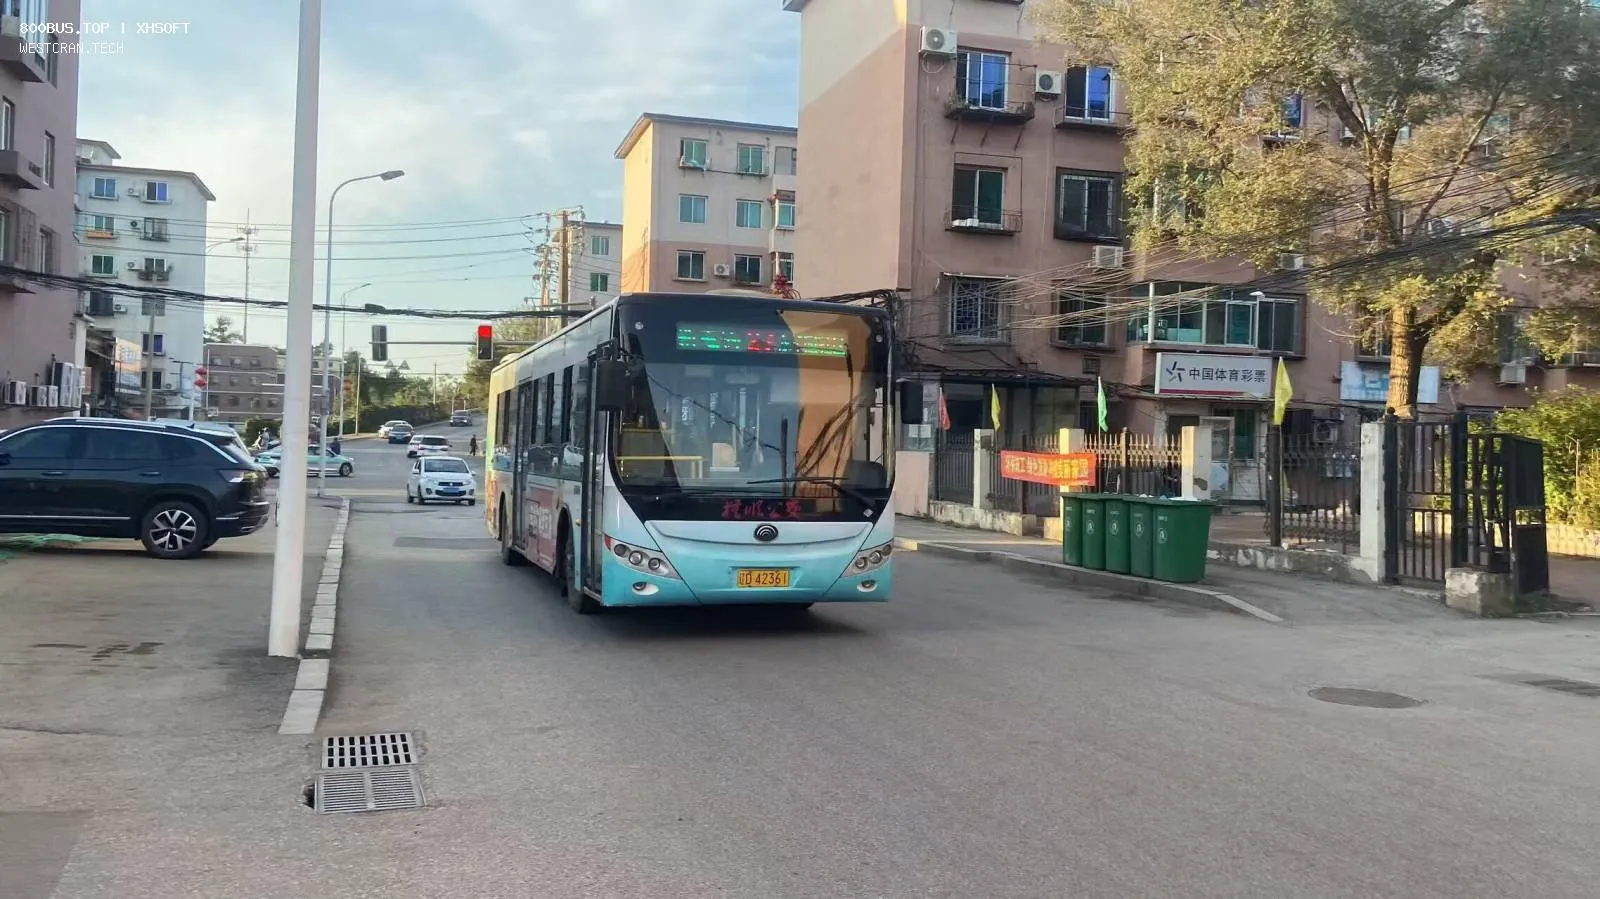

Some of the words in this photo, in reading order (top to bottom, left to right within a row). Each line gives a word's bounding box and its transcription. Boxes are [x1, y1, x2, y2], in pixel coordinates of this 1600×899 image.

[1189, 367, 1267, 382] 中国体育彩票
